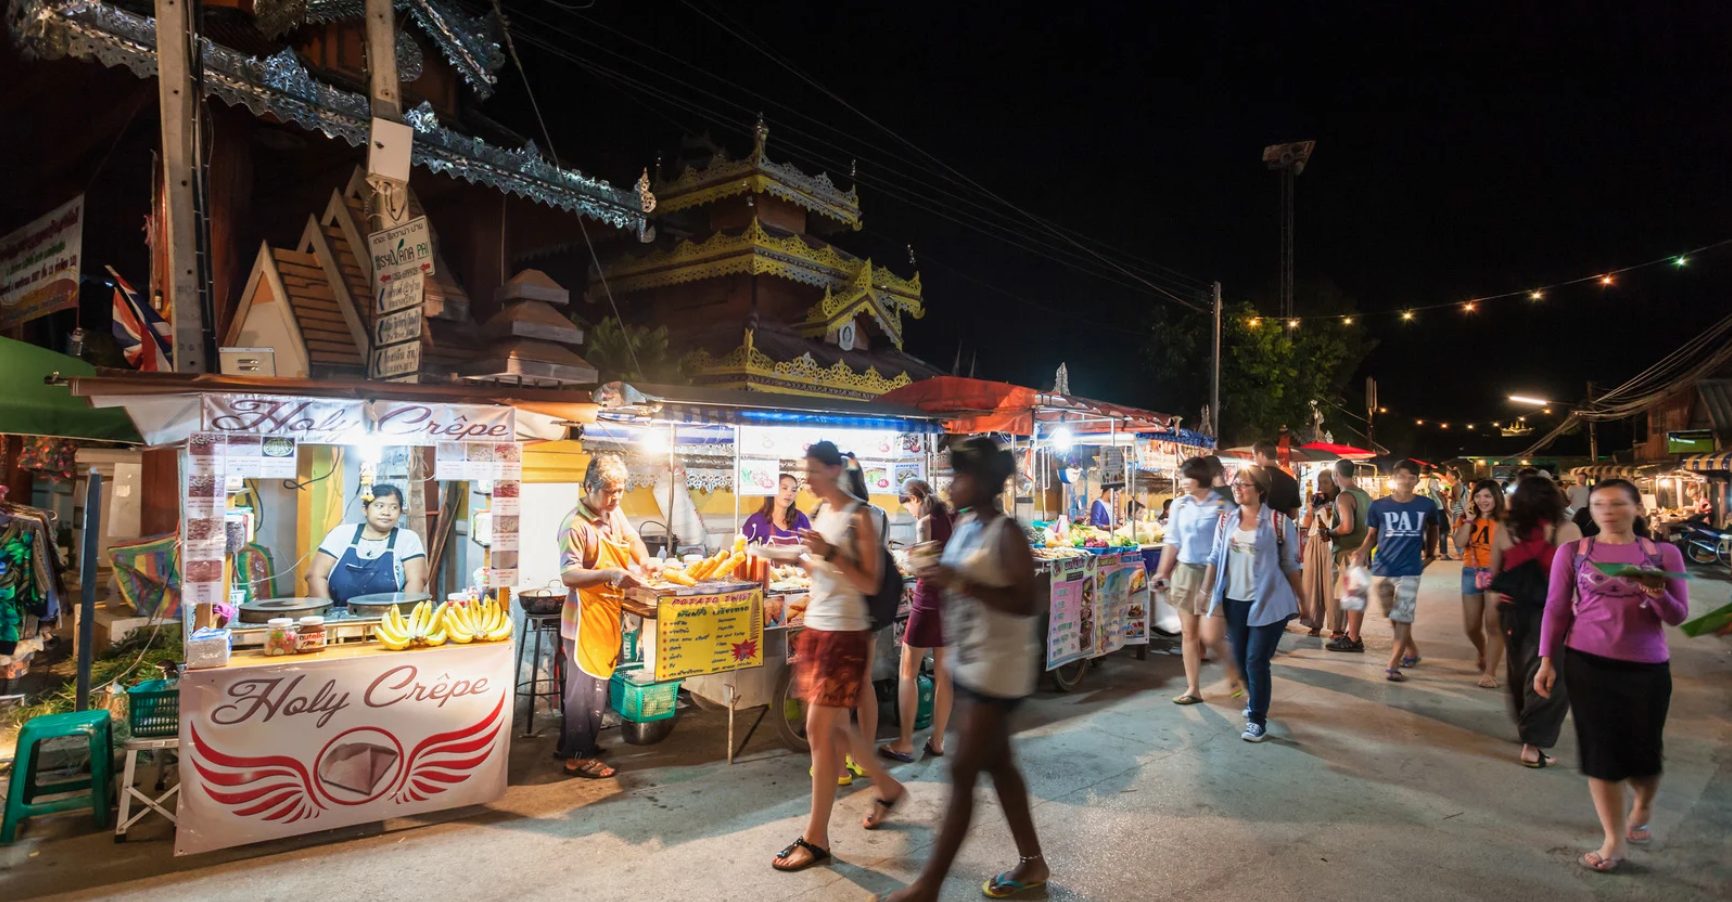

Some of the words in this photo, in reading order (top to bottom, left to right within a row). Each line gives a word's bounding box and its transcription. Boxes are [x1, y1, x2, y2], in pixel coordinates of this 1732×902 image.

[377, 405, 509, 441] Crêpe
[1383, 510, 1426, 531] PAI
[672, 596, 719, 607] POTATO
[211, 674, 350, 729] Holy
[364, 664, 490, 708] Crêpe
